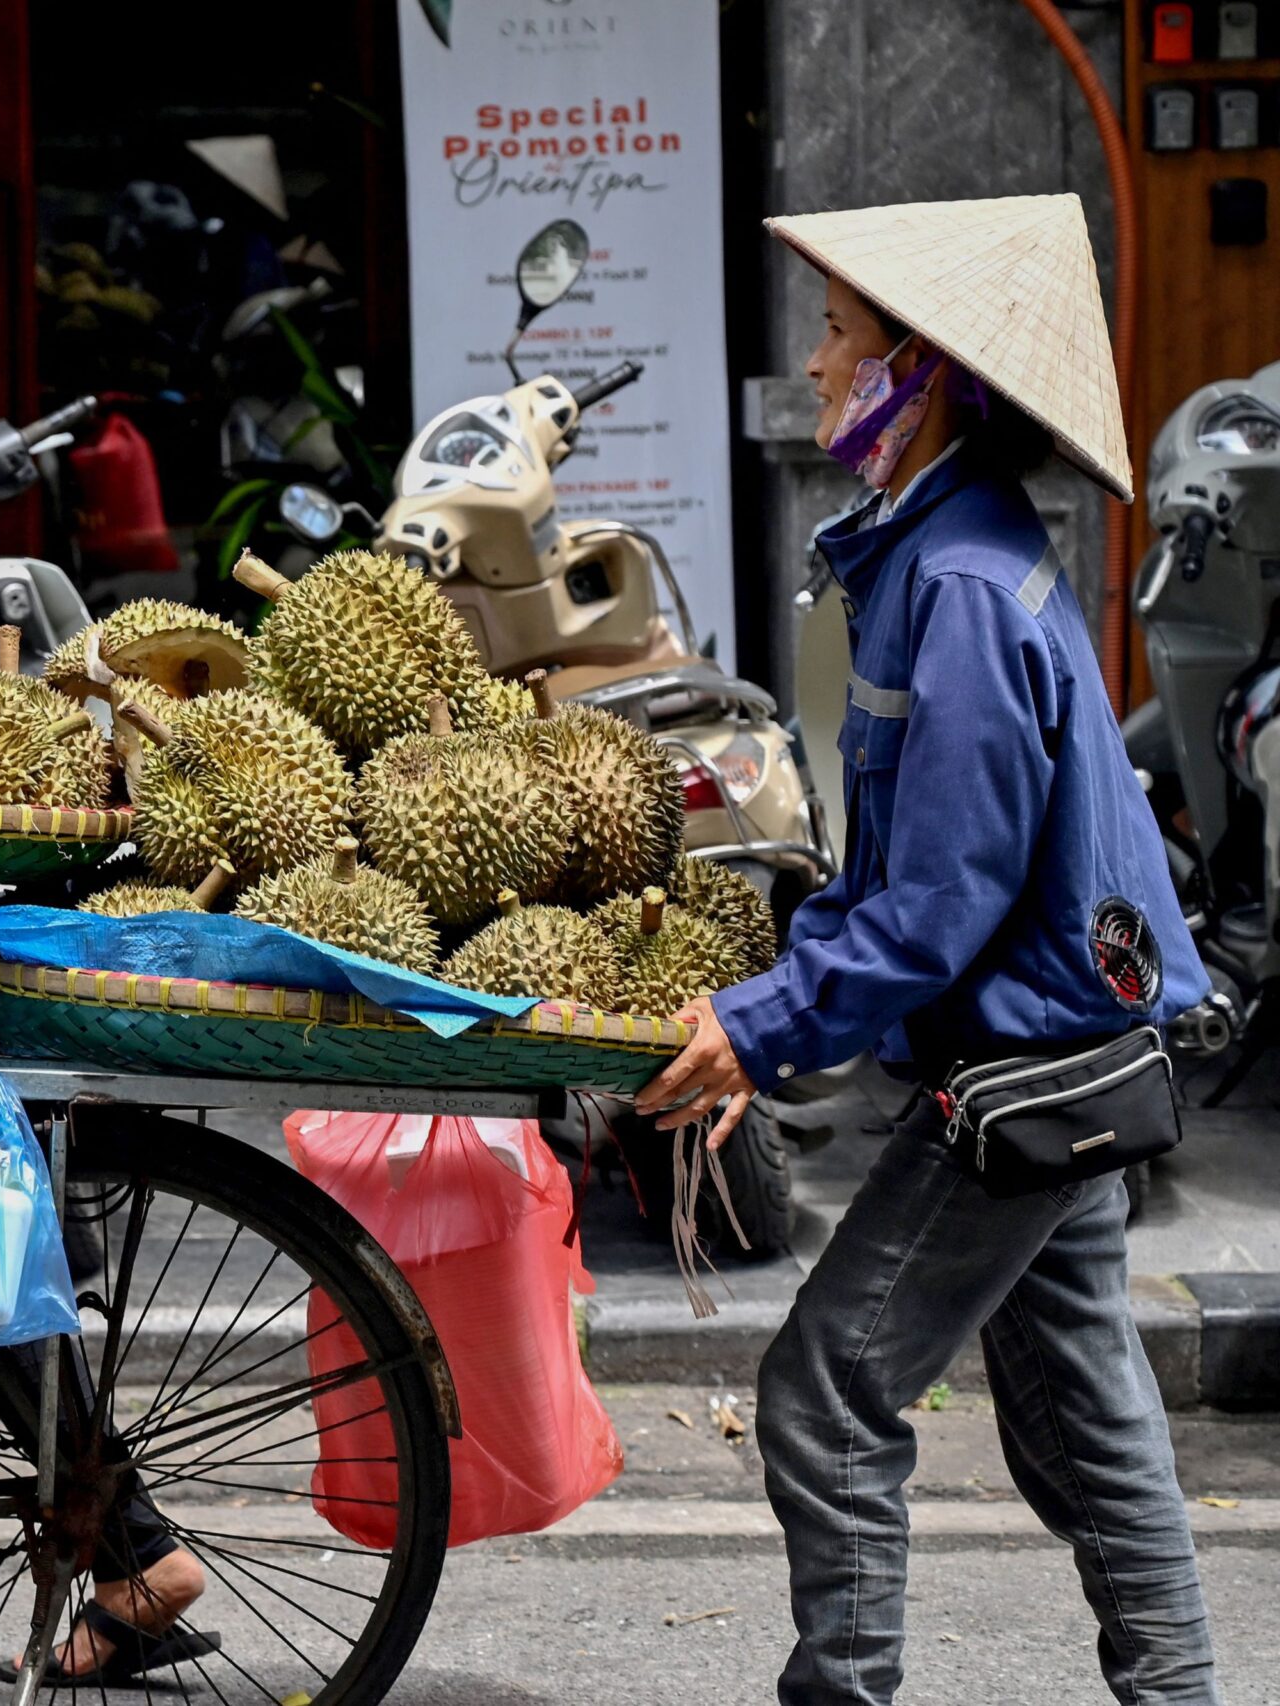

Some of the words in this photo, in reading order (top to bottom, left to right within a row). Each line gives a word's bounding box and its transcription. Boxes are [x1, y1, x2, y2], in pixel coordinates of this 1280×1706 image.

[498, 16, 617, 37] ORIENT
[477, 97, 647, 135] Special
[443, 127, 681, 160] Promotion
